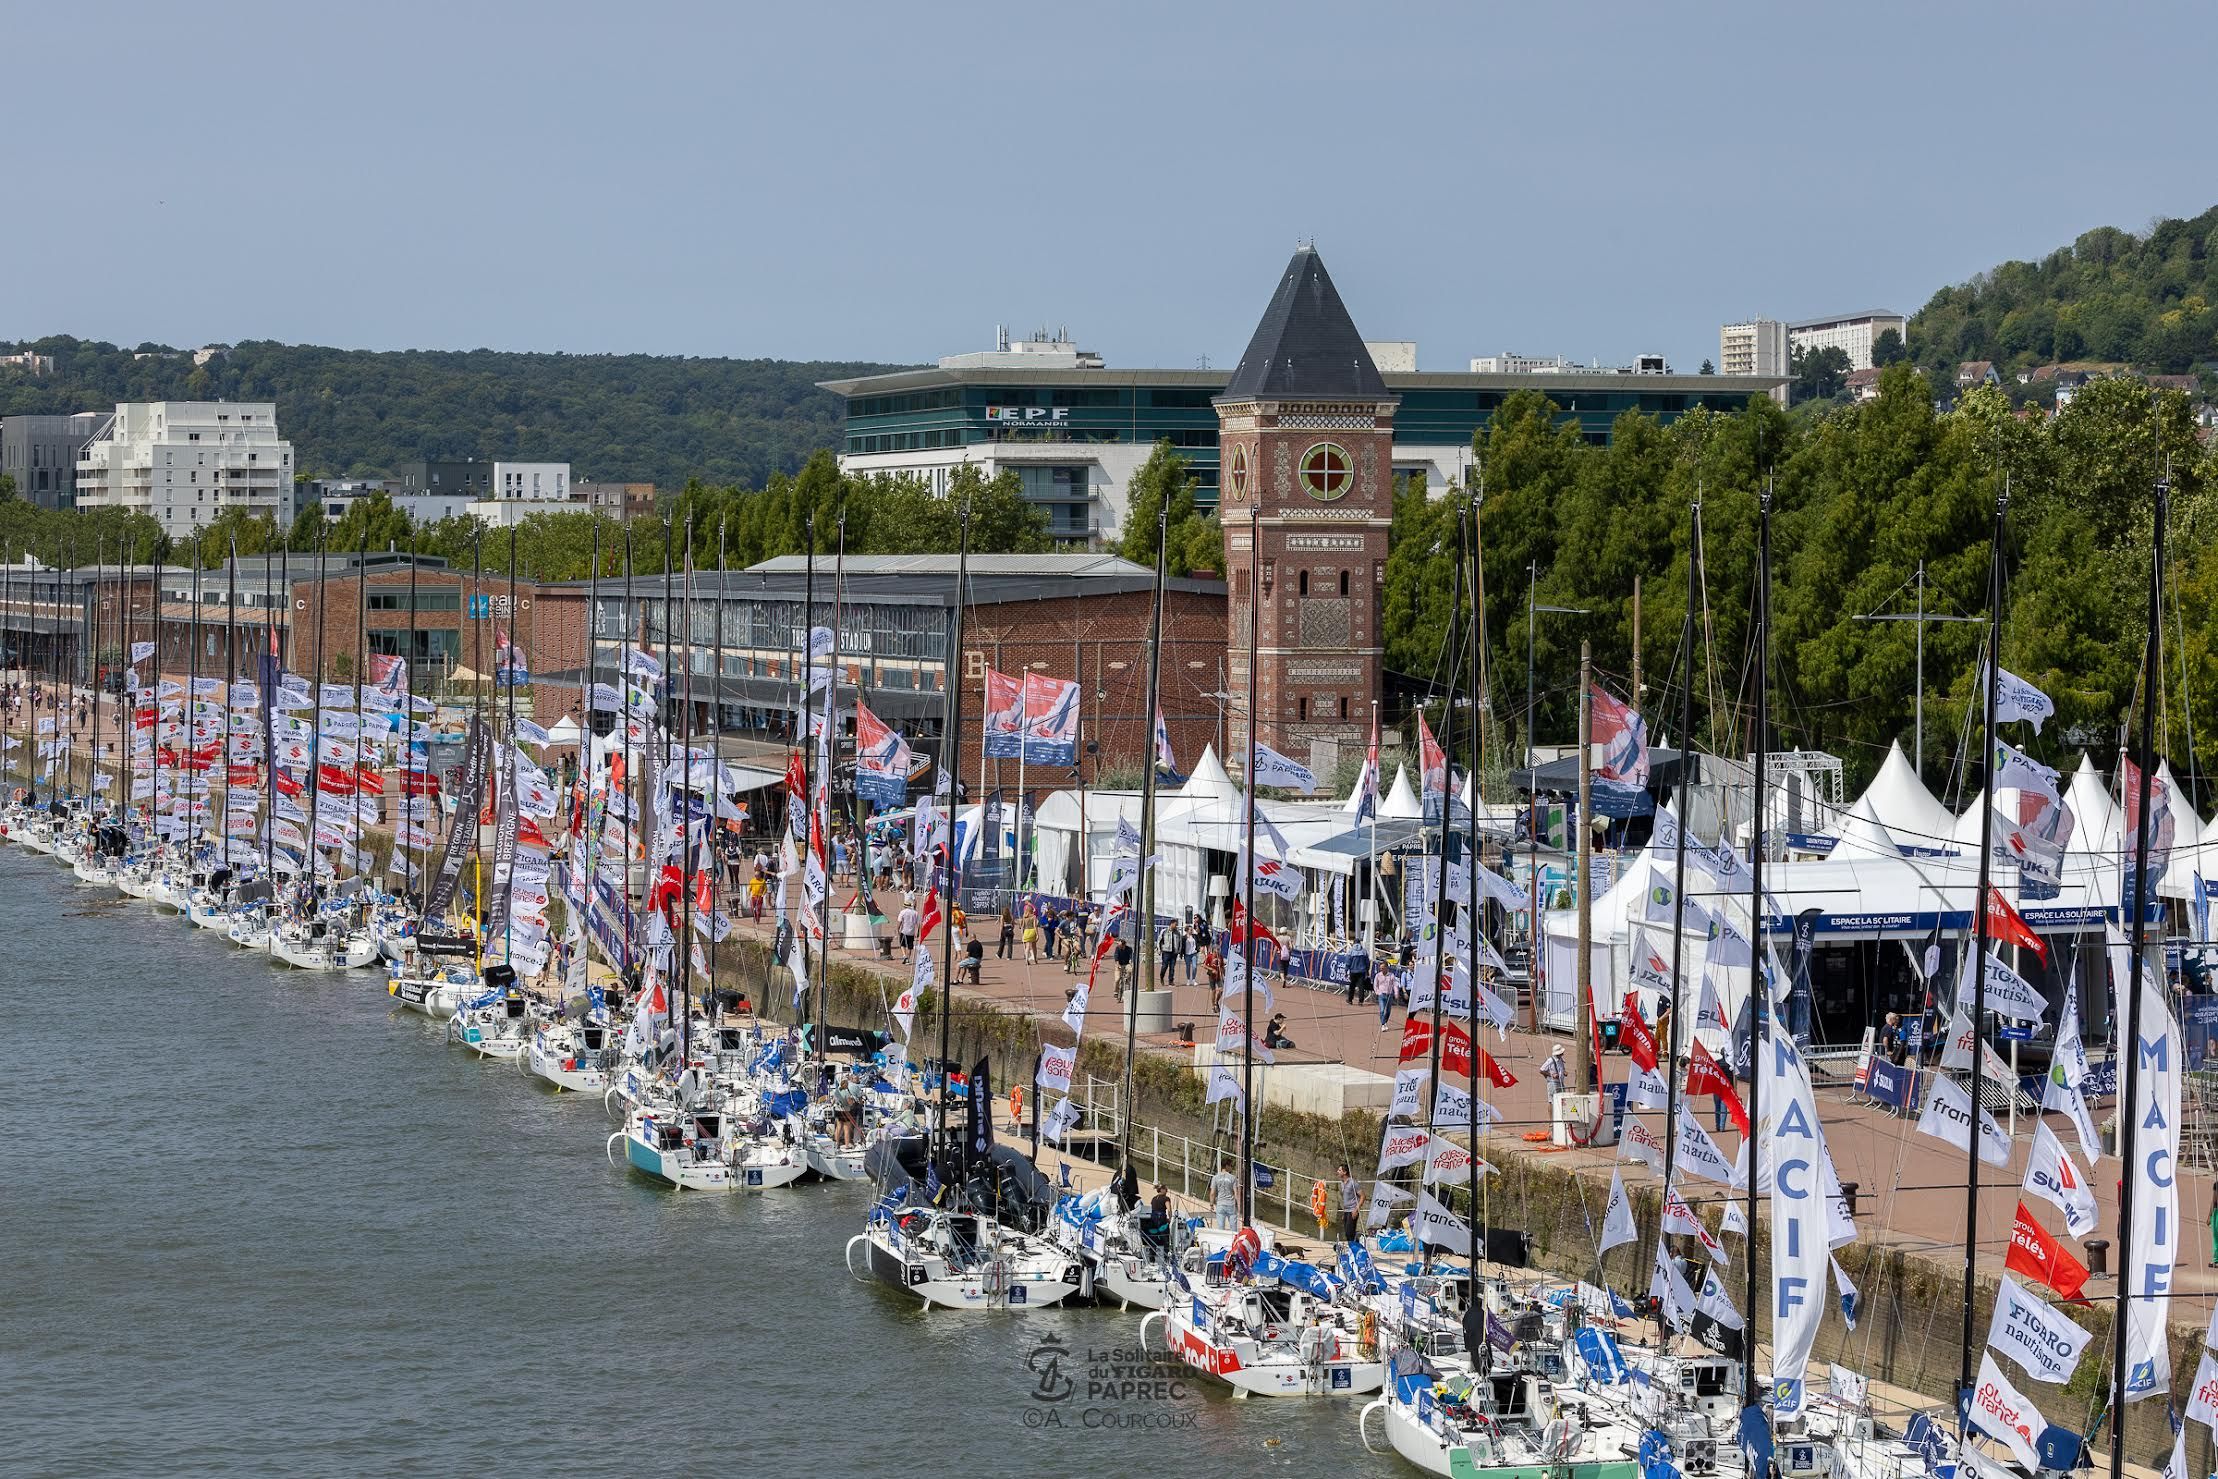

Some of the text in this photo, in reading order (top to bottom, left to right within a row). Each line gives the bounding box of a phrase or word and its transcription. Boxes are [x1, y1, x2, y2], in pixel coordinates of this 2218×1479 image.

[1002, 407, 1069, 421] EPF
[297, 600, 305, 609] C
[489, 595, 517, 607] eau
[521, 600, 530, 610] C
[964, 651, 985, 679] B
[458, 811, 477, 858] BRETAGNE
[502, 809, 517, 861] BRETAGNE
[1830, 917, 1860, 926] ESPACE
[1861, 917, 1872, 925] LA
[2025, 909, 2104, 920] ESPACE LA SOLITAIRE
[828, 1035, 864, 1048] almond
[974, 1075, 985, 1134] SUZUKI
[1775, 1037, 1814, 1318] MACIF
[2137, 1033, 2173, 1302] MACIF
[2009, 1299, 2074, 1359] FIGARO
[2005, 1322, 2062, 1373] nautisme
[1774, 1400, 1798, 1409] ACIF
